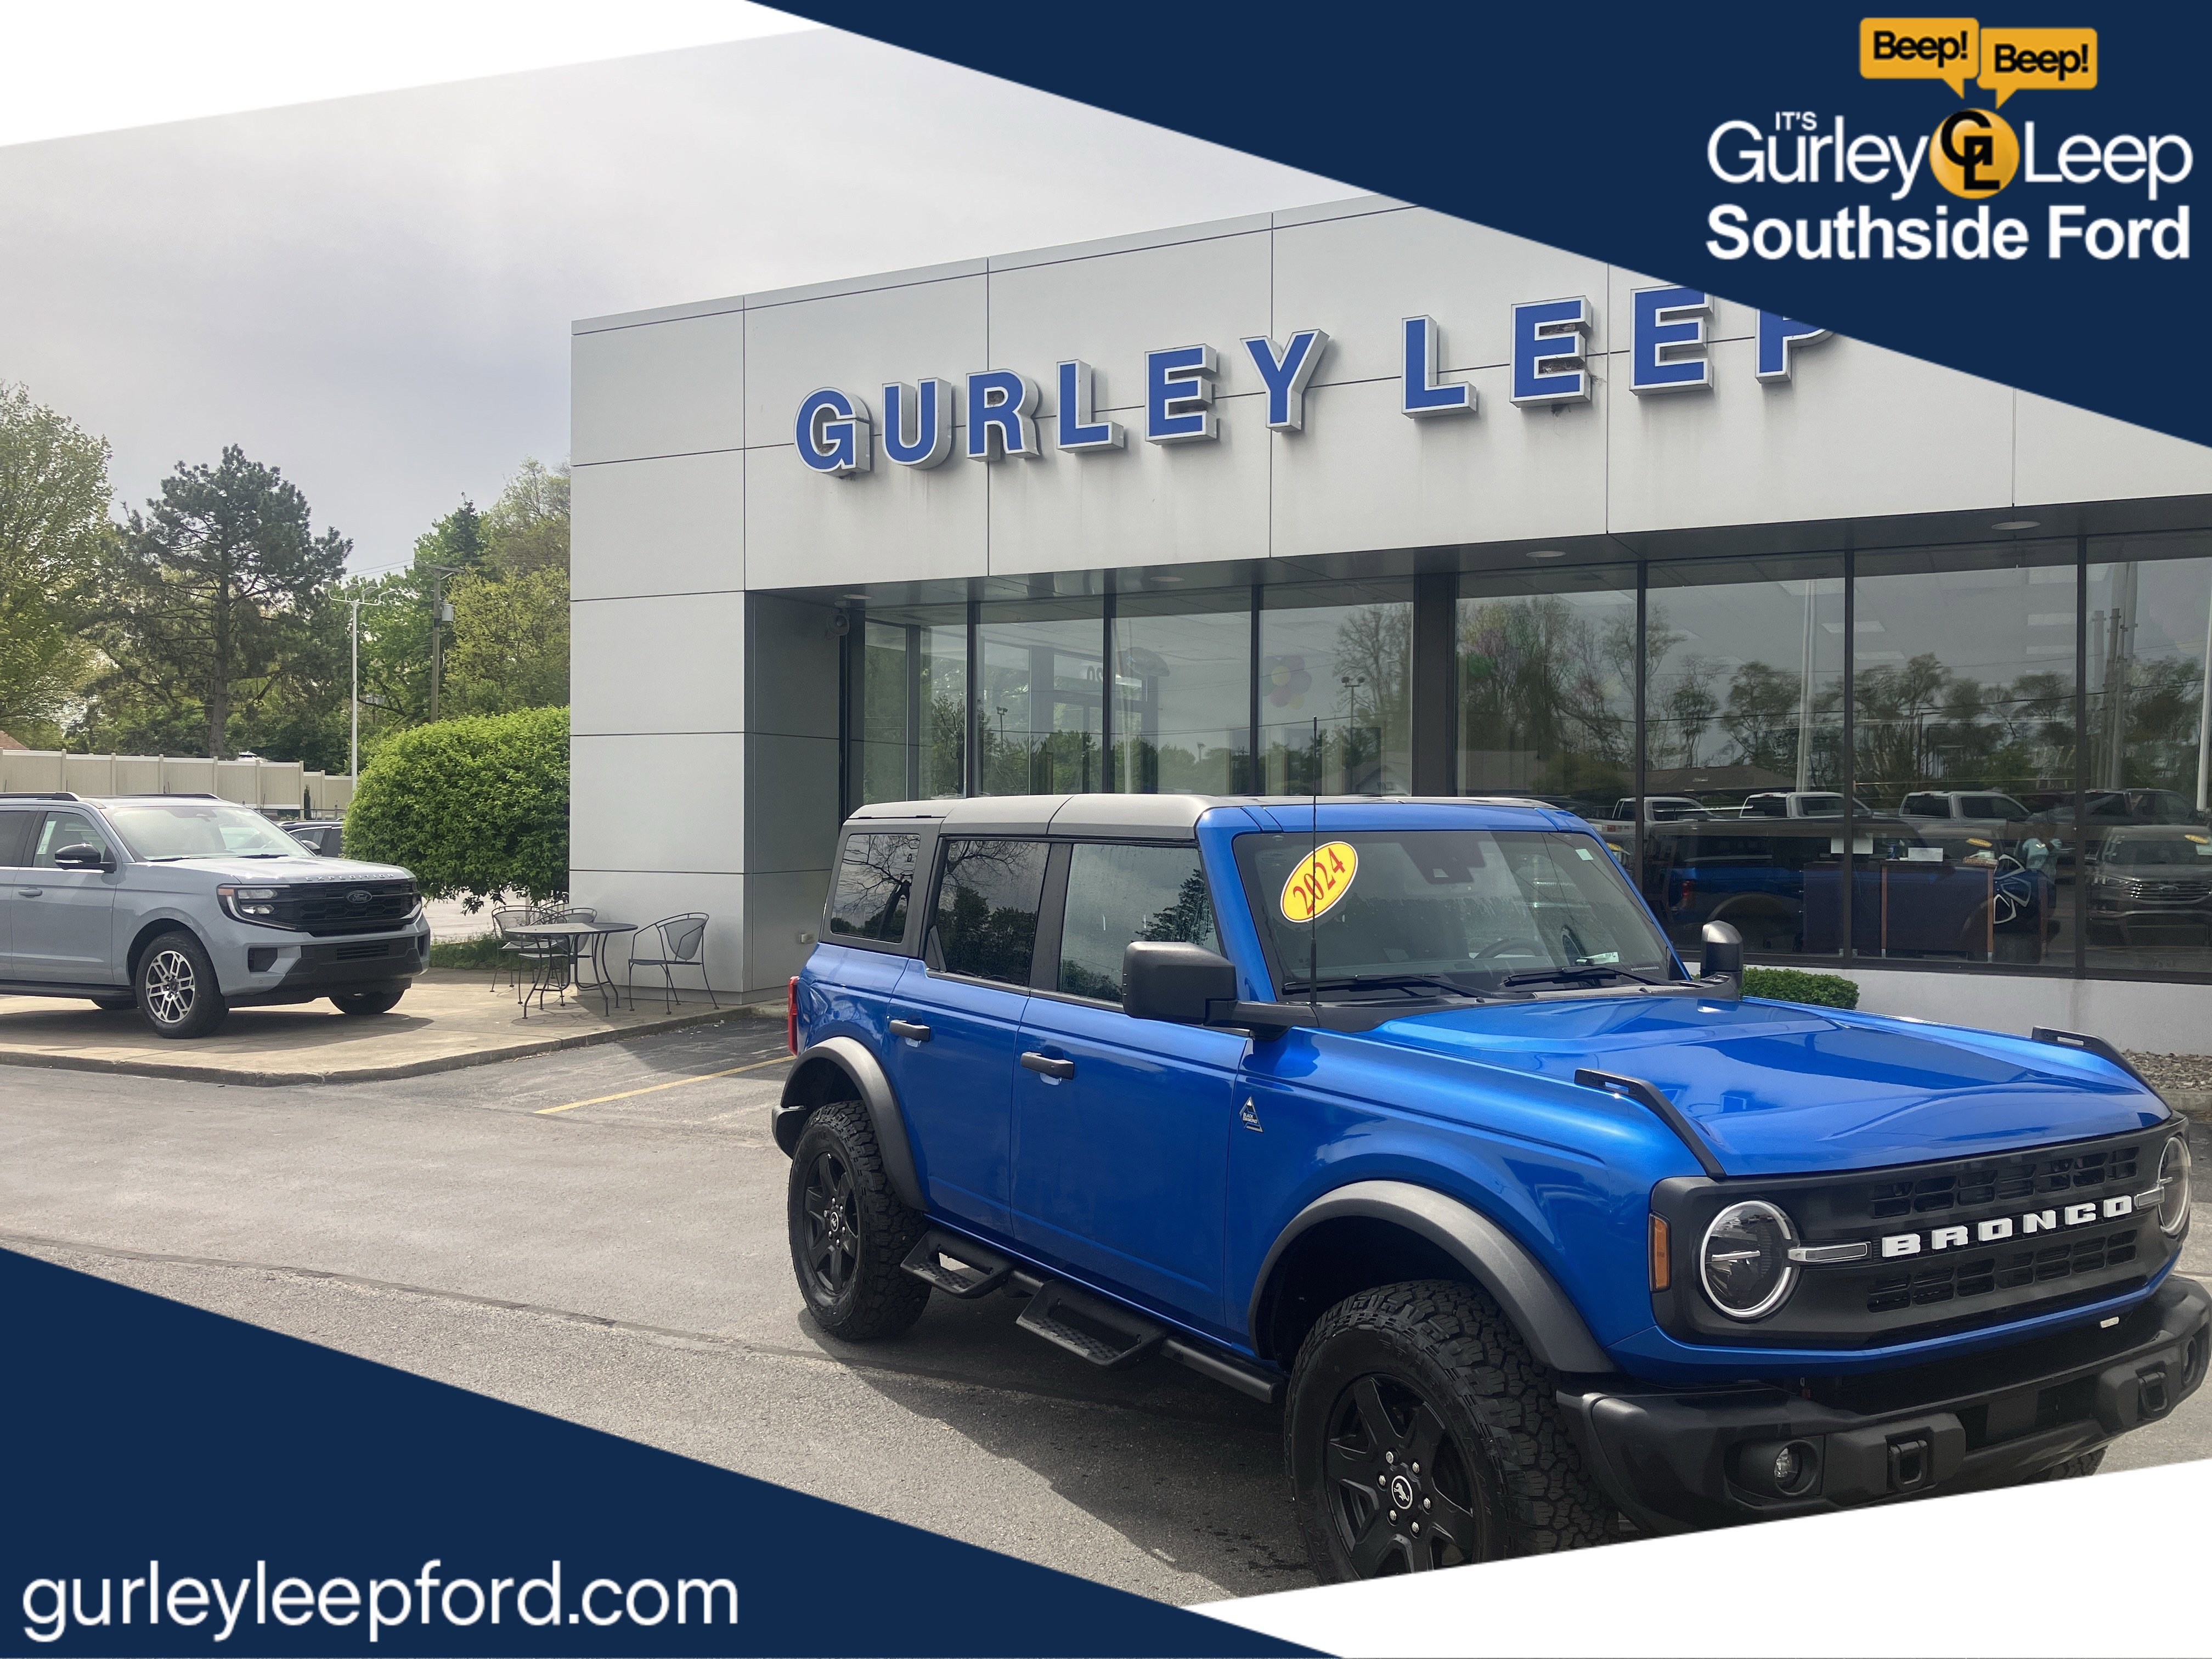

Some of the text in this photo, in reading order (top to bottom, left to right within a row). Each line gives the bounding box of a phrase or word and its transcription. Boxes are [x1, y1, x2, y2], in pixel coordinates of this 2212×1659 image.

[794, 329, 1330, 474] GURLEY
[352, 893, 368, 902] Ford
[1293, 847, 1346, 916] 2024
[1881, 1194, 2133, 1258] BRONCO
